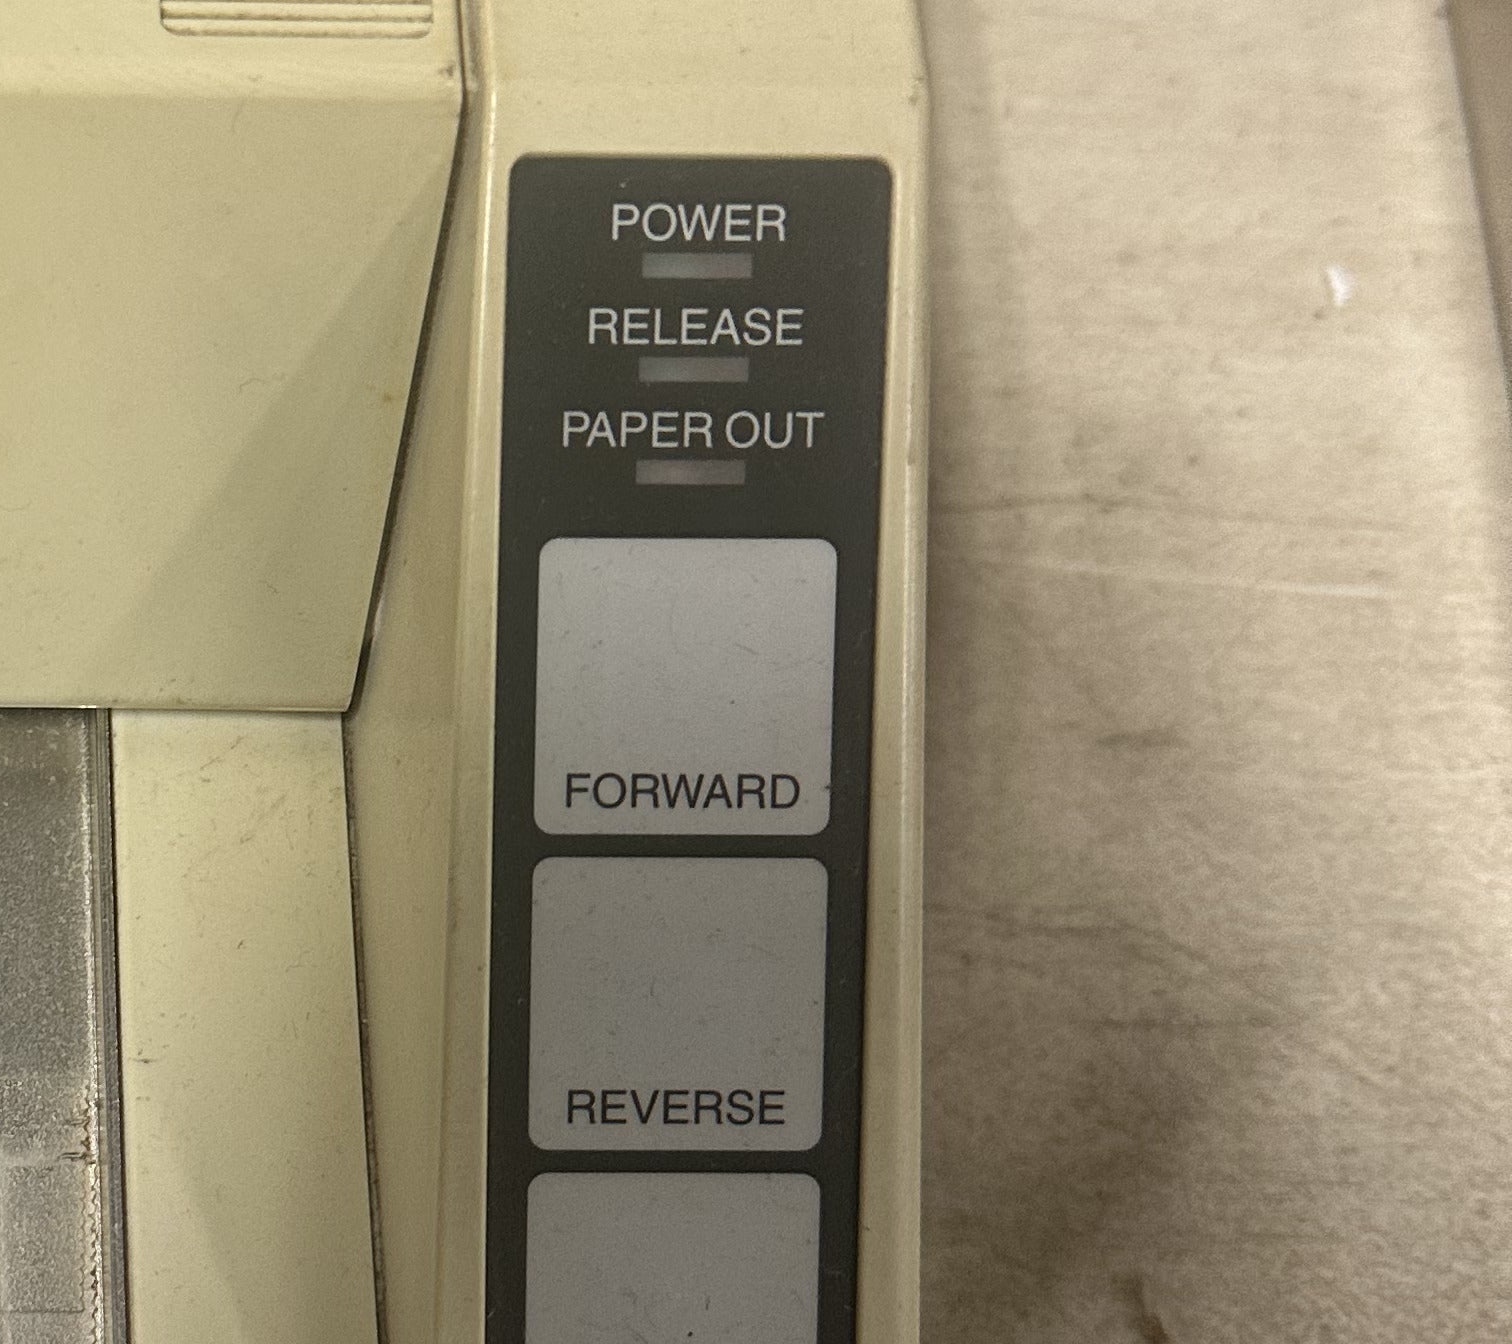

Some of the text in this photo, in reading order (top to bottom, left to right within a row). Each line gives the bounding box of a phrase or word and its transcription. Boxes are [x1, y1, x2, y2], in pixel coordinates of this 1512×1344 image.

[611, 202, 786, 242] POWER
[588, 307, 804, 346] RELEASE
[562, 410, 825, 449] PAPER OUT
[565, 772, 801, 810] FORWARD
[567, 1088, 786, 1126] REVERSE
